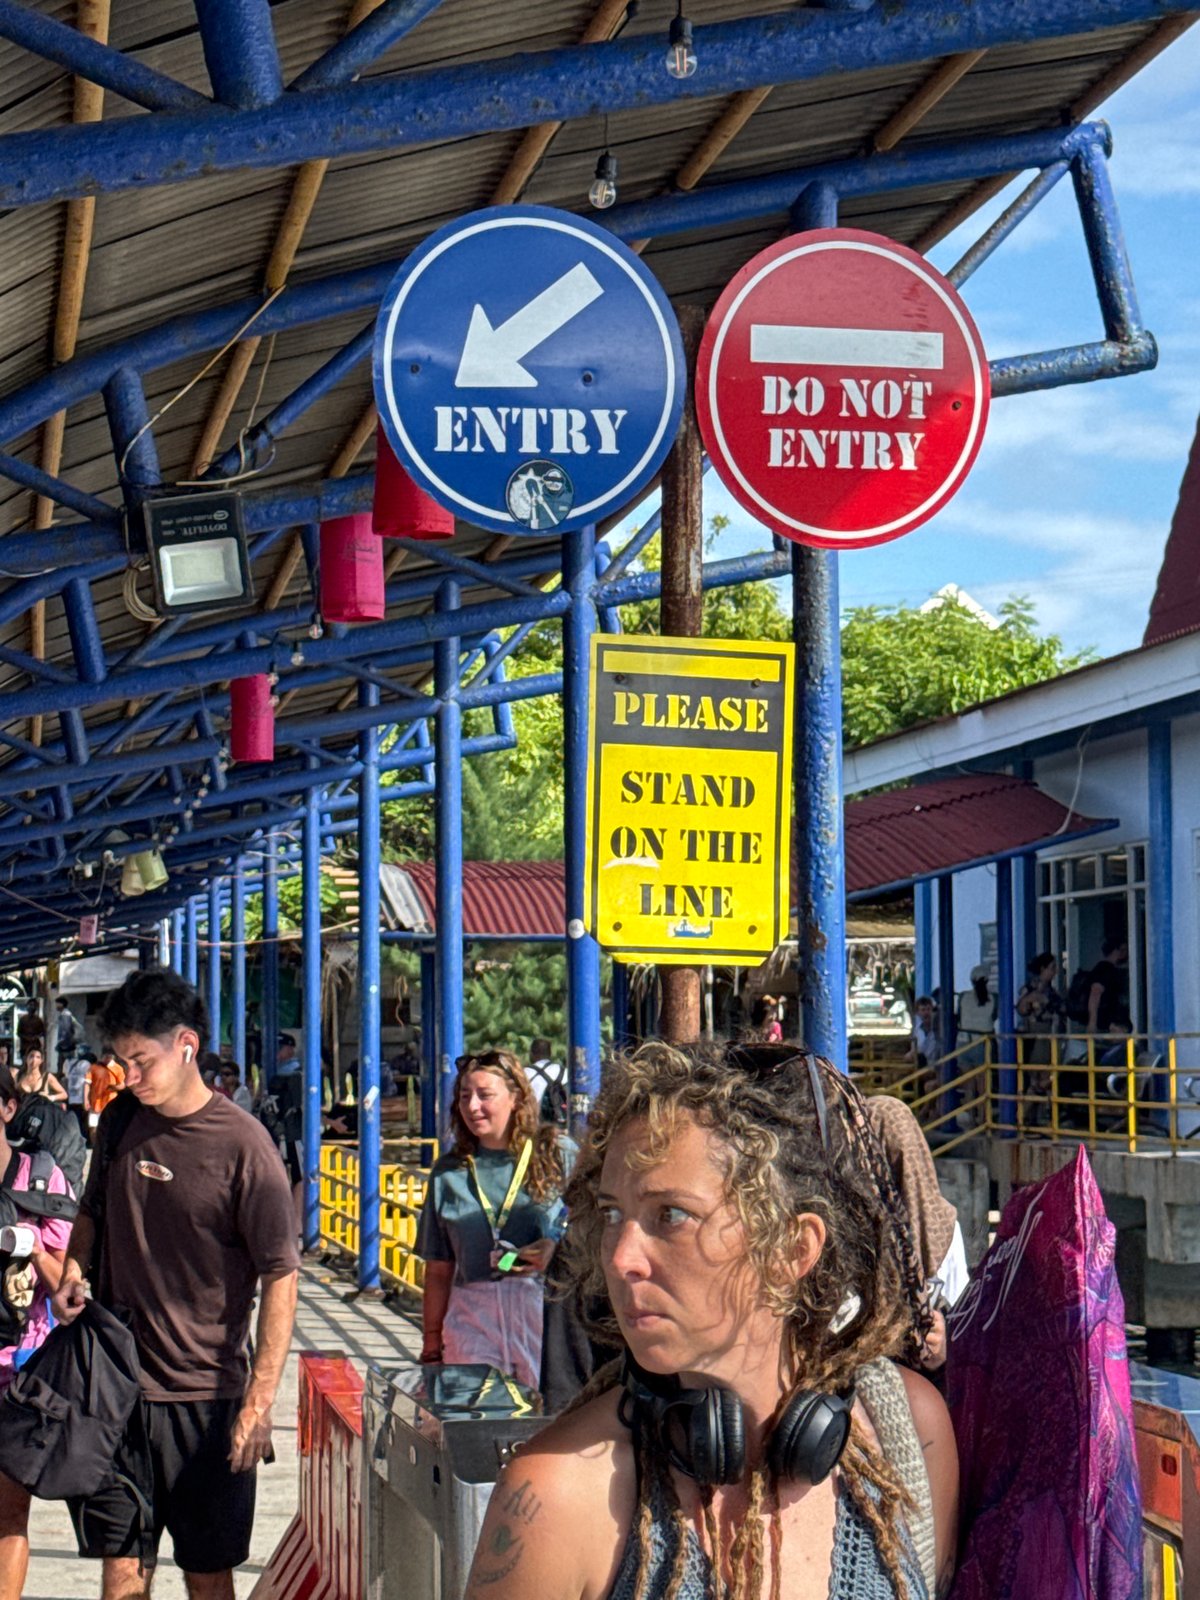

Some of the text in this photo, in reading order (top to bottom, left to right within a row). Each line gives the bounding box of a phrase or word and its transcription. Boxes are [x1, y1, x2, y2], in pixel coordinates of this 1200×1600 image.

[761, 375, 933, 420] DO NOT
[433, 405, 628, 455] ENTRY
[767, 428, 926, 471] ENTRY
[612, 692, 769, 733] PLEASE
[620, 770, 756, 809] STAND
[610, 826, 763, 865] ON THE
[638, 883, 733, 919] LINE
